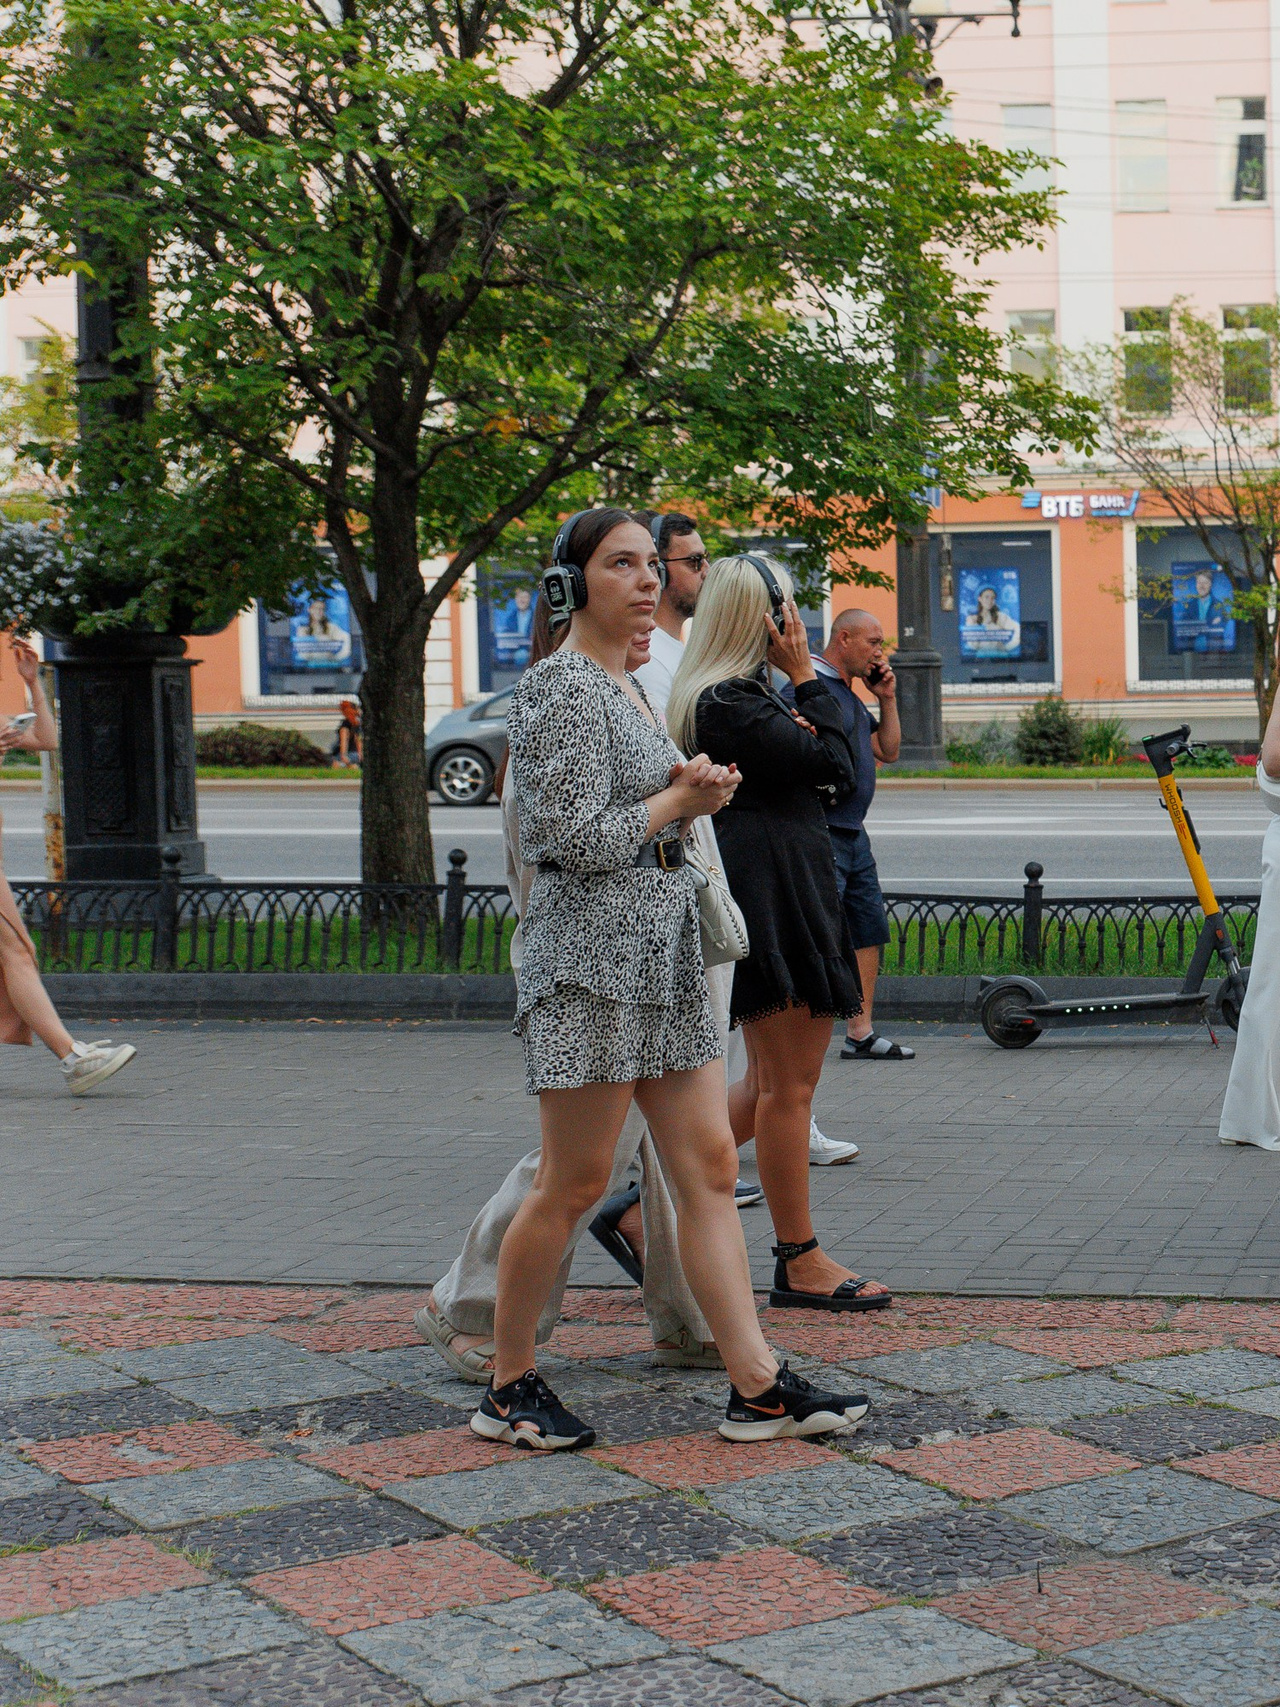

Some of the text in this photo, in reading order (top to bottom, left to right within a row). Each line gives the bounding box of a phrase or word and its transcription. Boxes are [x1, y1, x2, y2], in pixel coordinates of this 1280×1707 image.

[1041, 495, 1125, 518] ВТБ БАНК
[1165, 783, 1183, 824] WHOOSH
